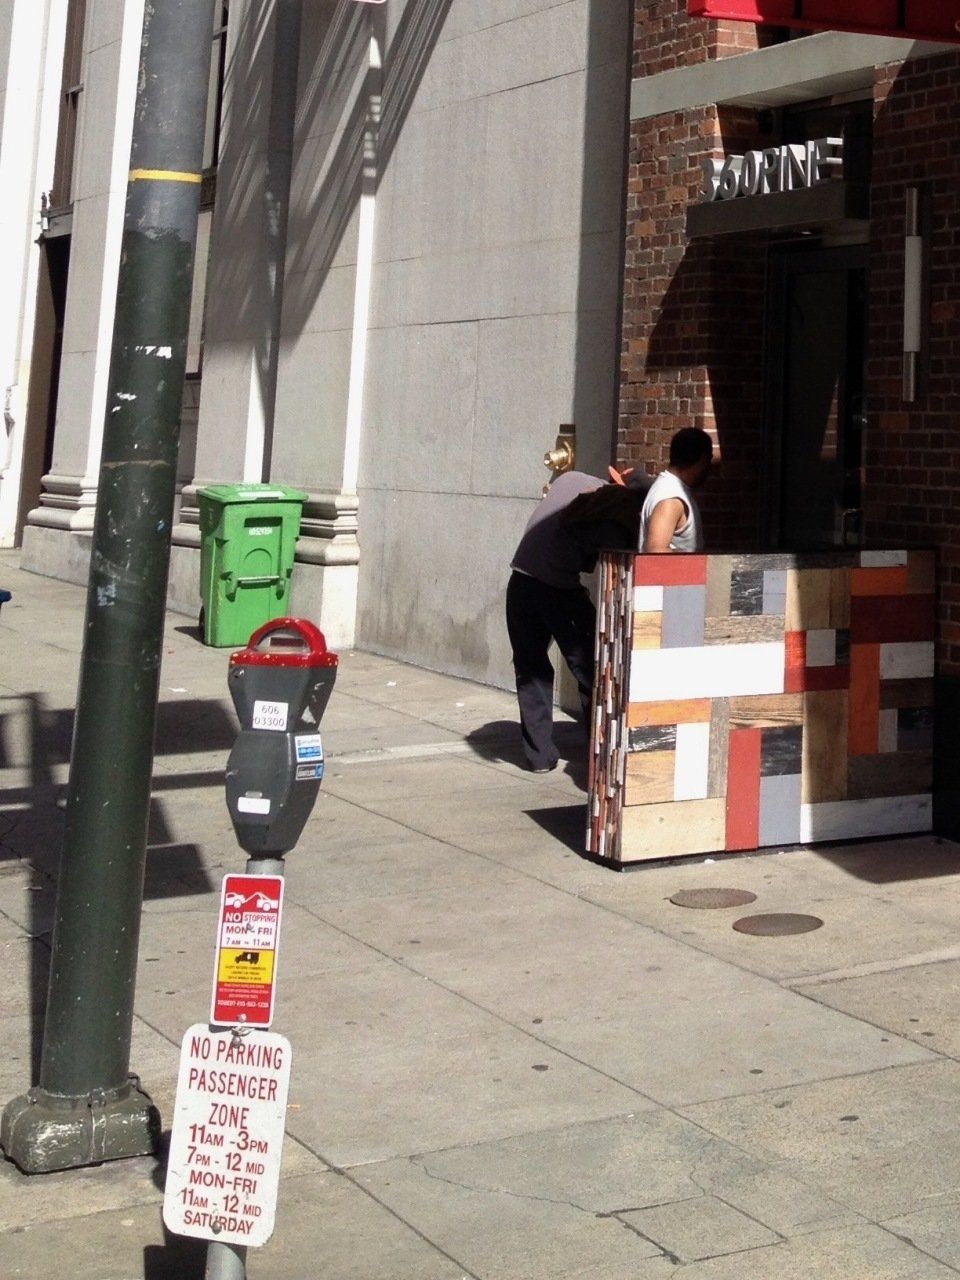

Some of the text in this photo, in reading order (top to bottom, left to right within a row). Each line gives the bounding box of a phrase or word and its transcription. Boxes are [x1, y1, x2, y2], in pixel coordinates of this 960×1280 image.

[262, 705, 280, 715] 606
[225, 912, 276, 923] NO STOPPING
[226, 926, 248, 934] MON
[257, 927, 273, 935] FRI
[190, 1034, 283, 1070] NO PARKING
[188, 1069, 278, 1102] PASSENGER
[208, 1103, 250, 1130] ZONE
[225, 1152, 242, 1171] 12
[246, 1160, 265, 1176] MID
[189, 1169, 257, 1195] MON-FRI
[222, 1195, 239, 1213] 12
[243, 1203, 262, 1218] MID
[183, 1209, 254, 1235] SATURDAY
